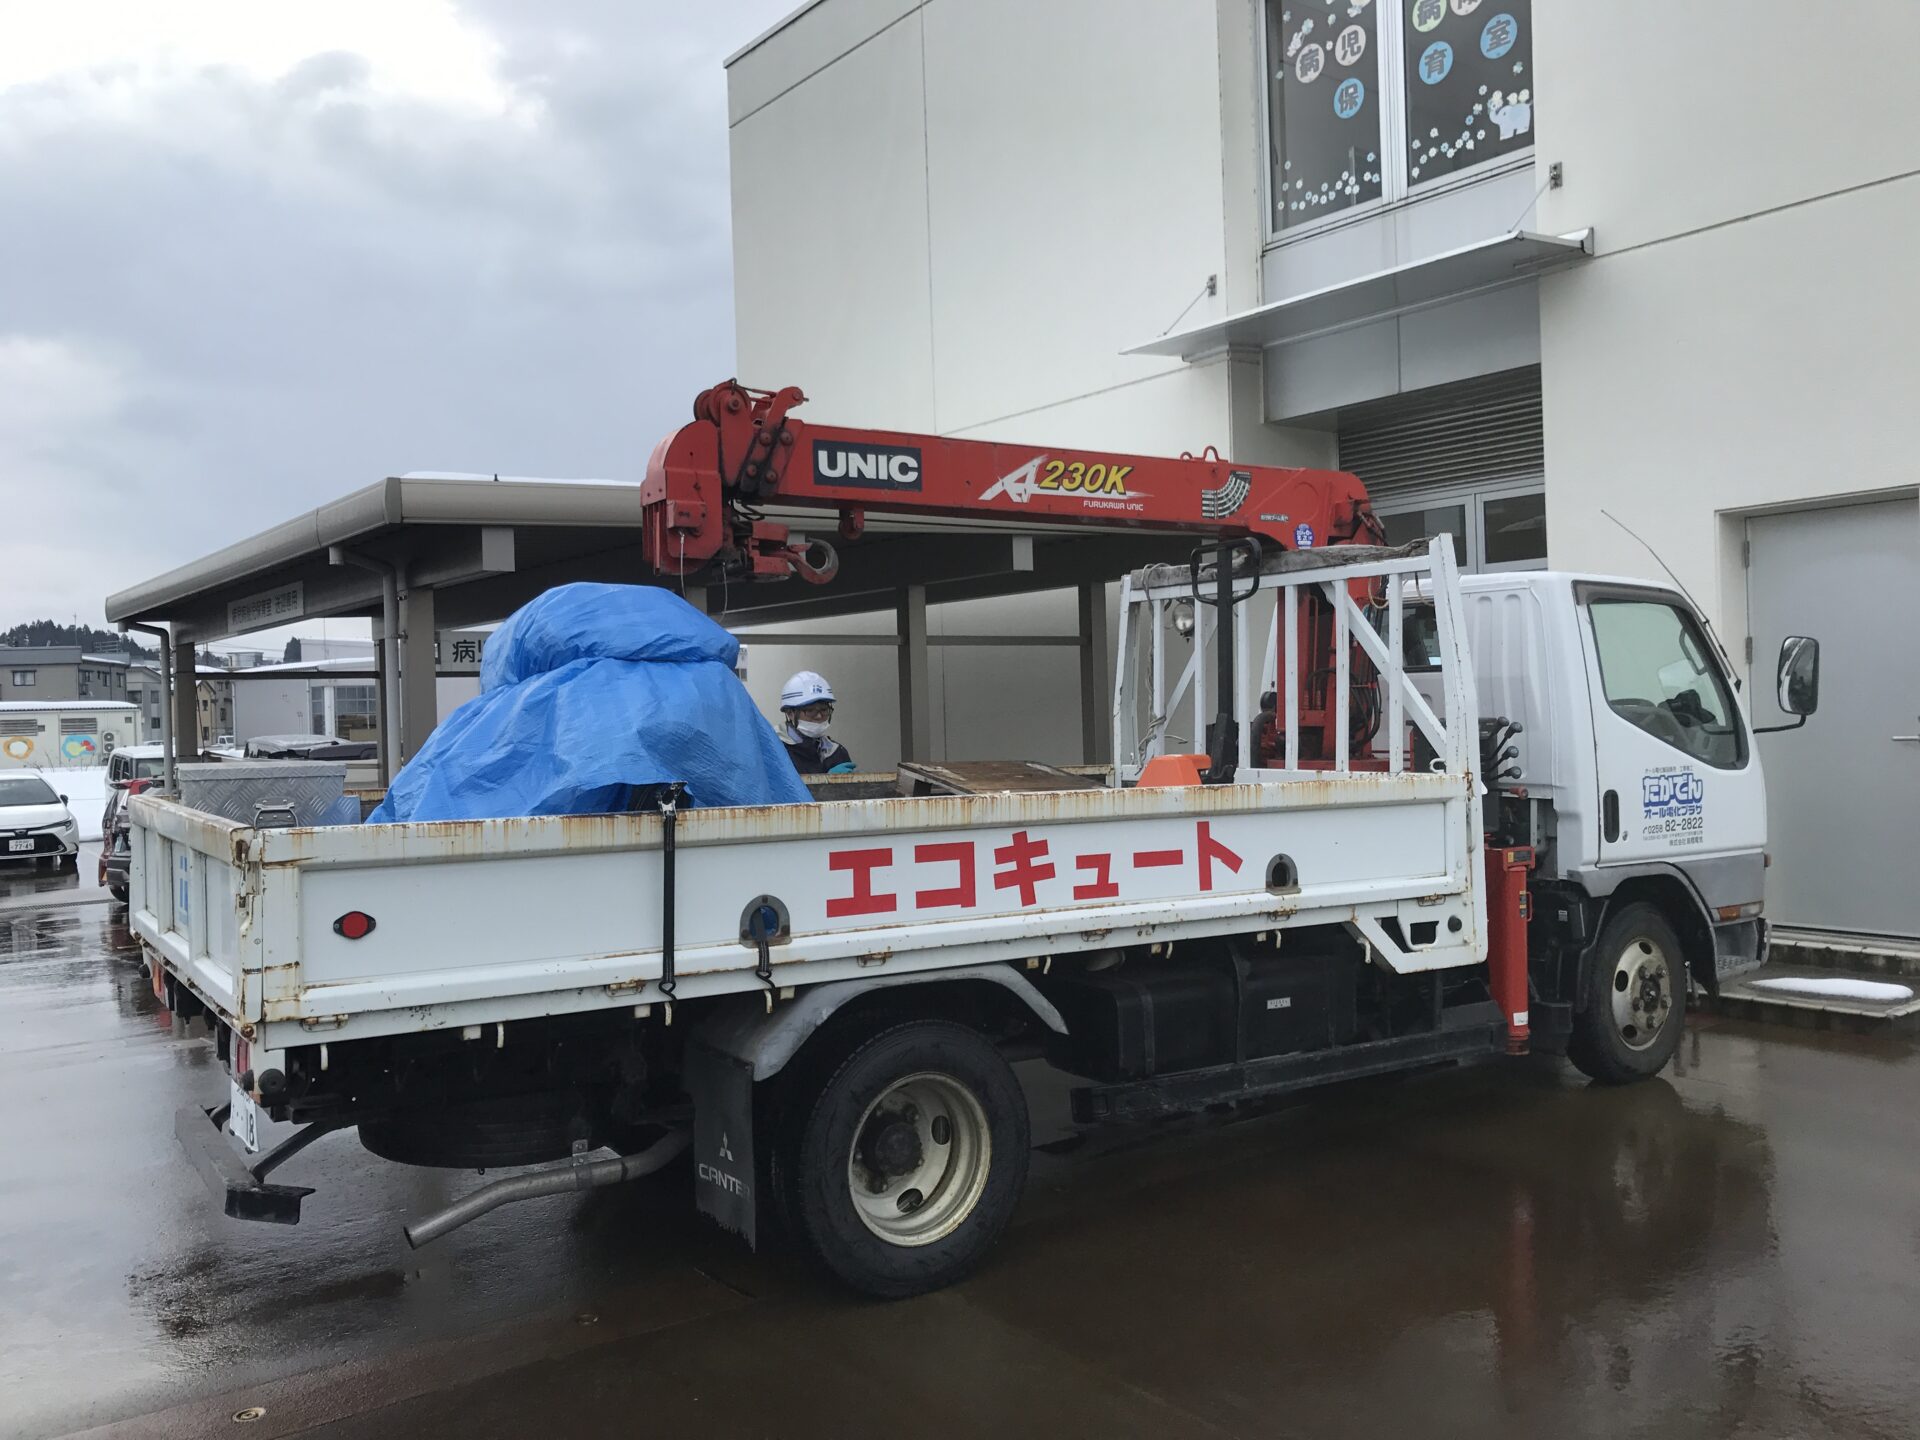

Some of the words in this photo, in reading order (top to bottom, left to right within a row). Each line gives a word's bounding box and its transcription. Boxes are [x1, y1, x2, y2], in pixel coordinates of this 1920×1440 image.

[818, 450, 919, 483] UNIC
[1039, 460, 1133, 495] 230K
[1083, 500, 1125, 510] FURUKAWA
[1127, 503, 1144, 511] UNIC
[1665, 817, 1703, 832] 82-2822
[826, 820, 1243, 918] エコキュート
